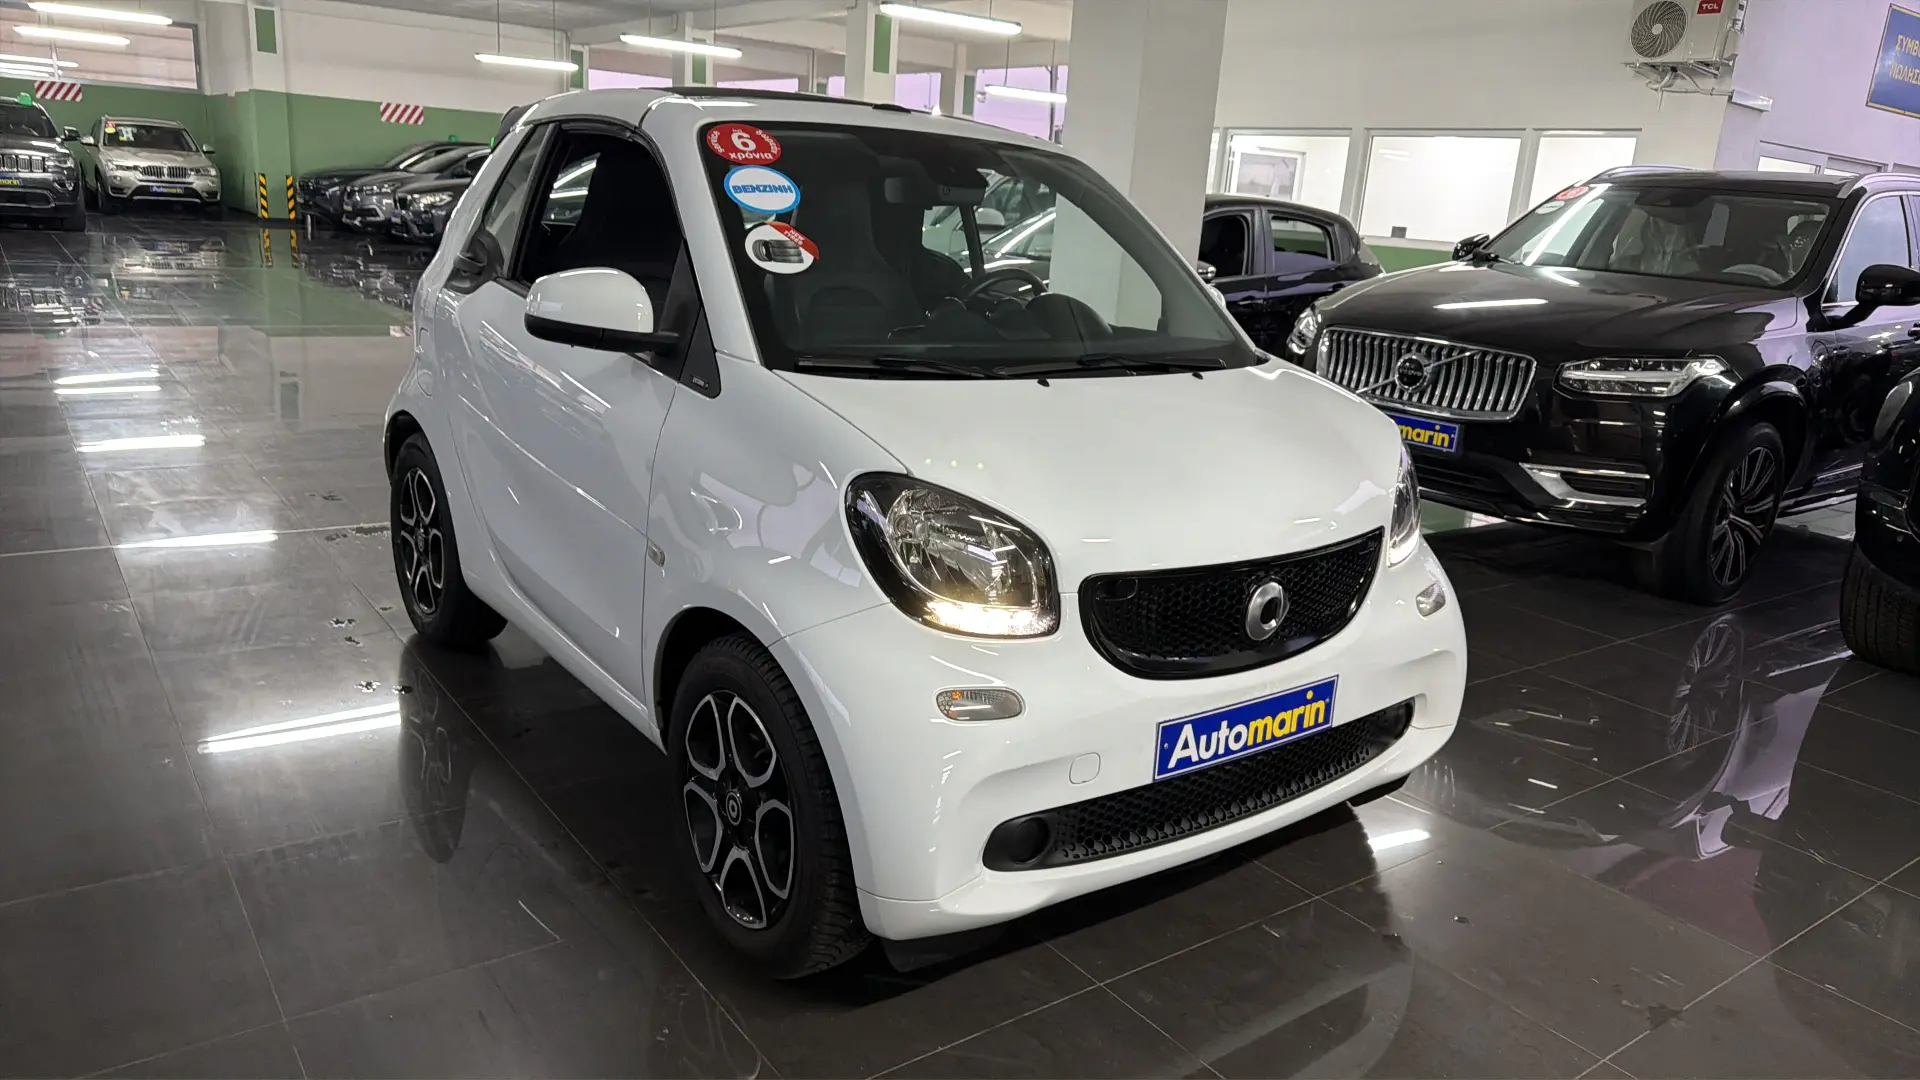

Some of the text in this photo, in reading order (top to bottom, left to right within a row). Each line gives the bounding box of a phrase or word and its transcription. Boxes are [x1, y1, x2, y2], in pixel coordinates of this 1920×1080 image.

[1896, 34, 1920, 57] ΣΥΜΒ
[1889, 62, 1920, 86] ΠΩΛΗΣ
[731, 132, 757, 151] 6
[729, 151, 773, 160] χρόνια
[789, 229, 805, 241] NEW
[1167, 690, 1326, 769] Automarin
